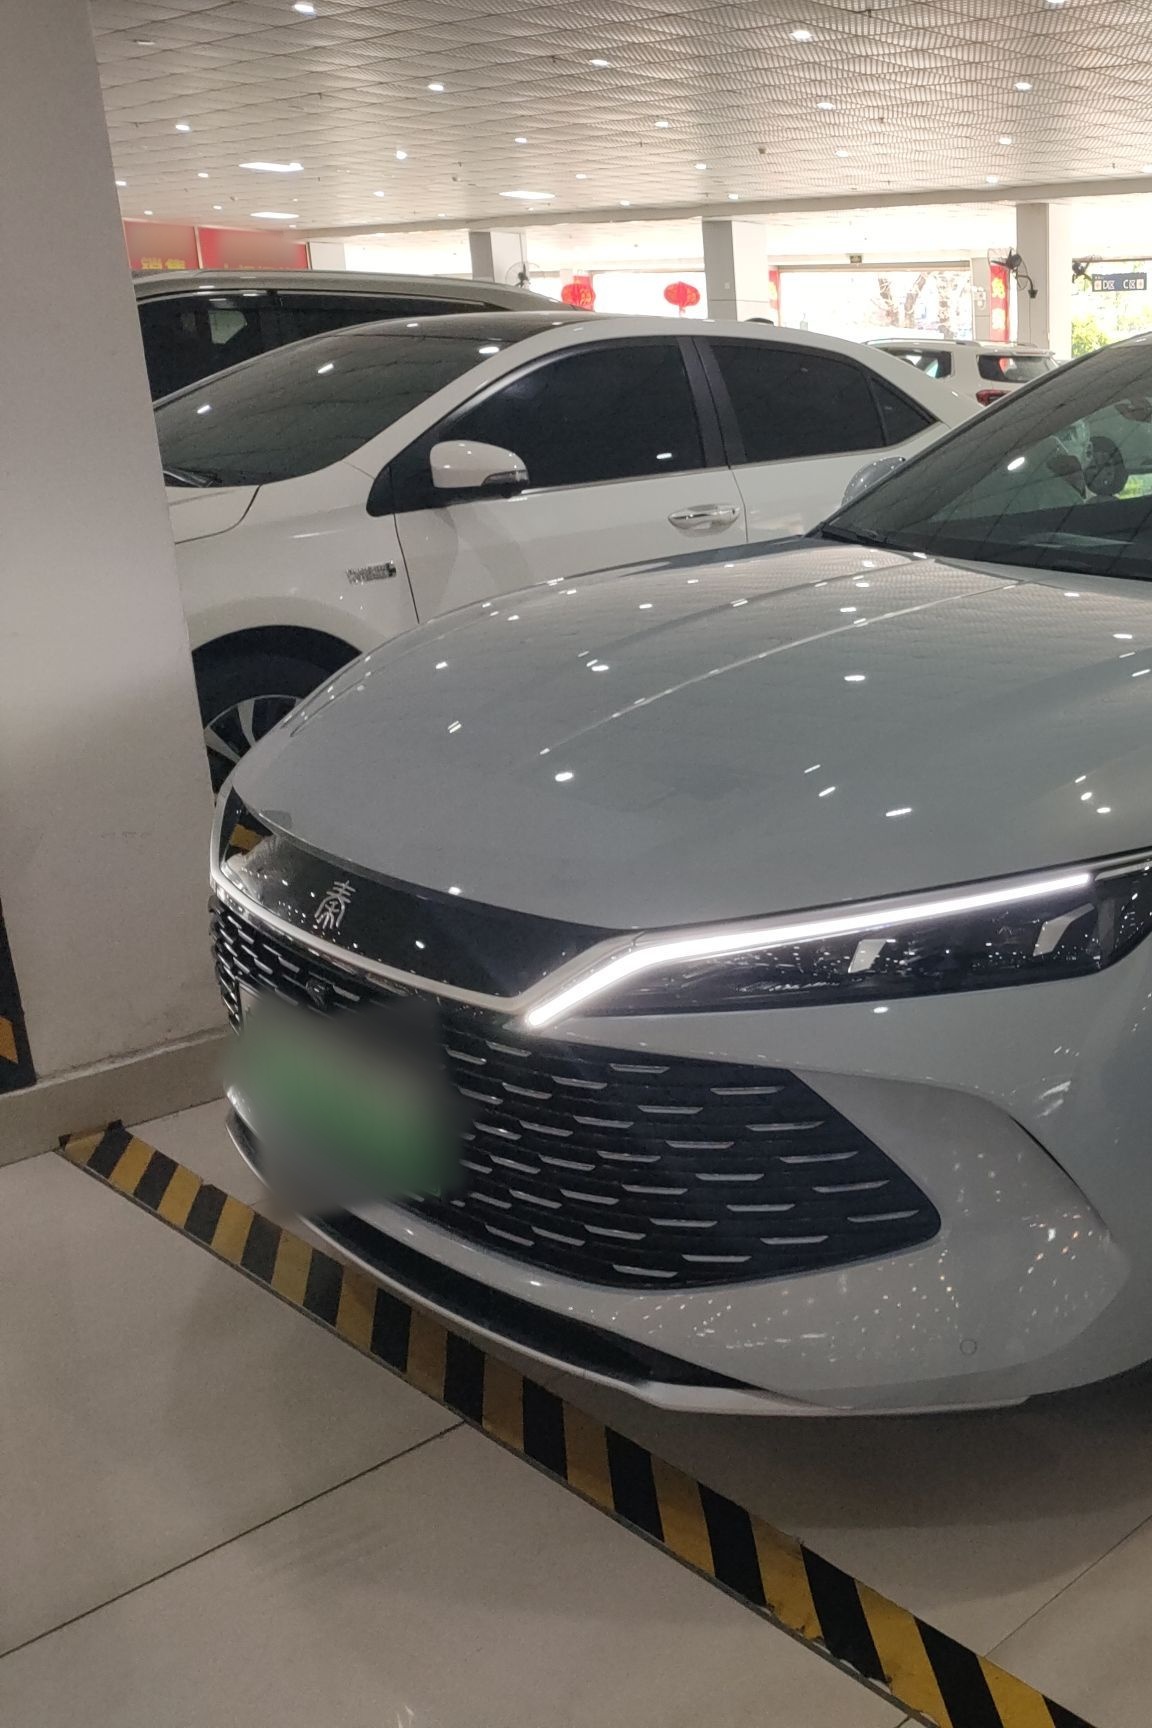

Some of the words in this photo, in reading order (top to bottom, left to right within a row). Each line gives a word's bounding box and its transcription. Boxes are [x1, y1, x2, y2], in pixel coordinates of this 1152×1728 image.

[1103, 279, 1115, 290] D区
[1123, 279, 1136, 290] C区
[314, 880, 357, 930] 秦
